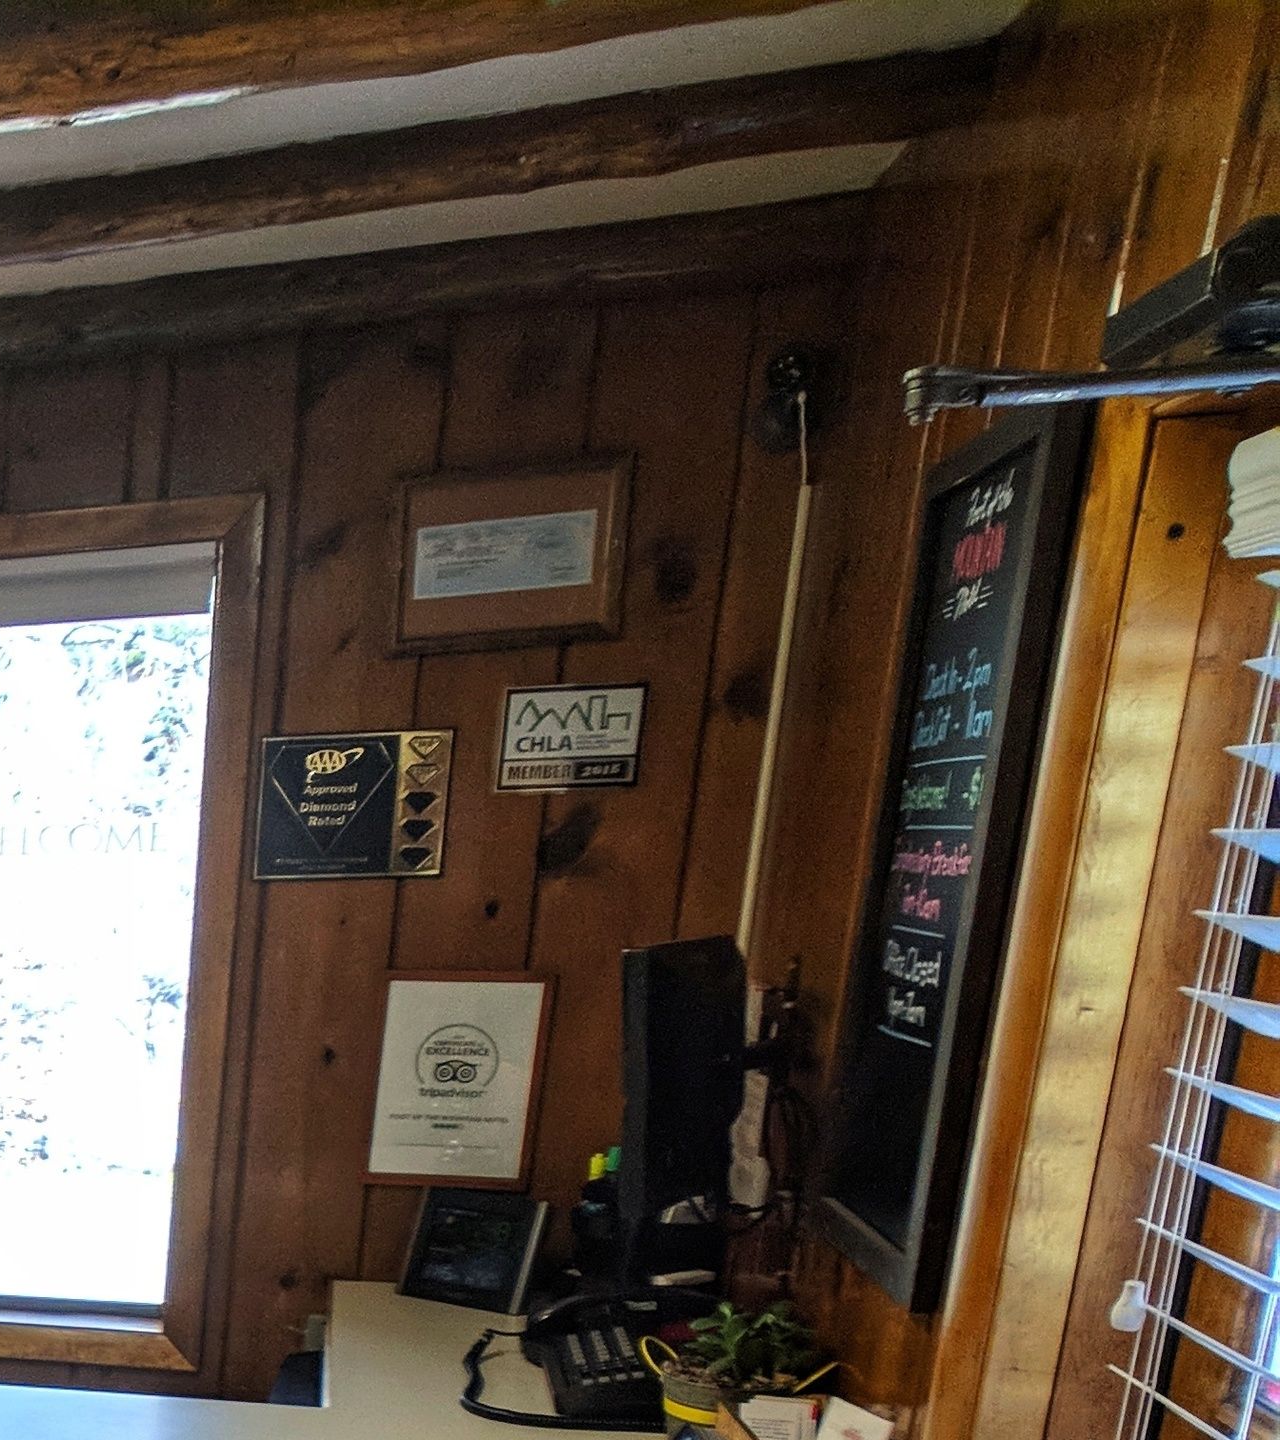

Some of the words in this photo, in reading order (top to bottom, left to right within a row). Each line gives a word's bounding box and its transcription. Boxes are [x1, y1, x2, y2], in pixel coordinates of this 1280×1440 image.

[515, 734, 572, 753] CHLA
[309, 751, 342, 771] AAA
[507, 764, 572, 780] MEMBER
[303, 782, 358, 796] Approved
[299, 801, 357, 813] Diamond
[308, 815, 346, 827] Rated
[425, 1046, 489, 1056] EXCELLENCE
[419, 1087, 484, 1099] tripadvisor
